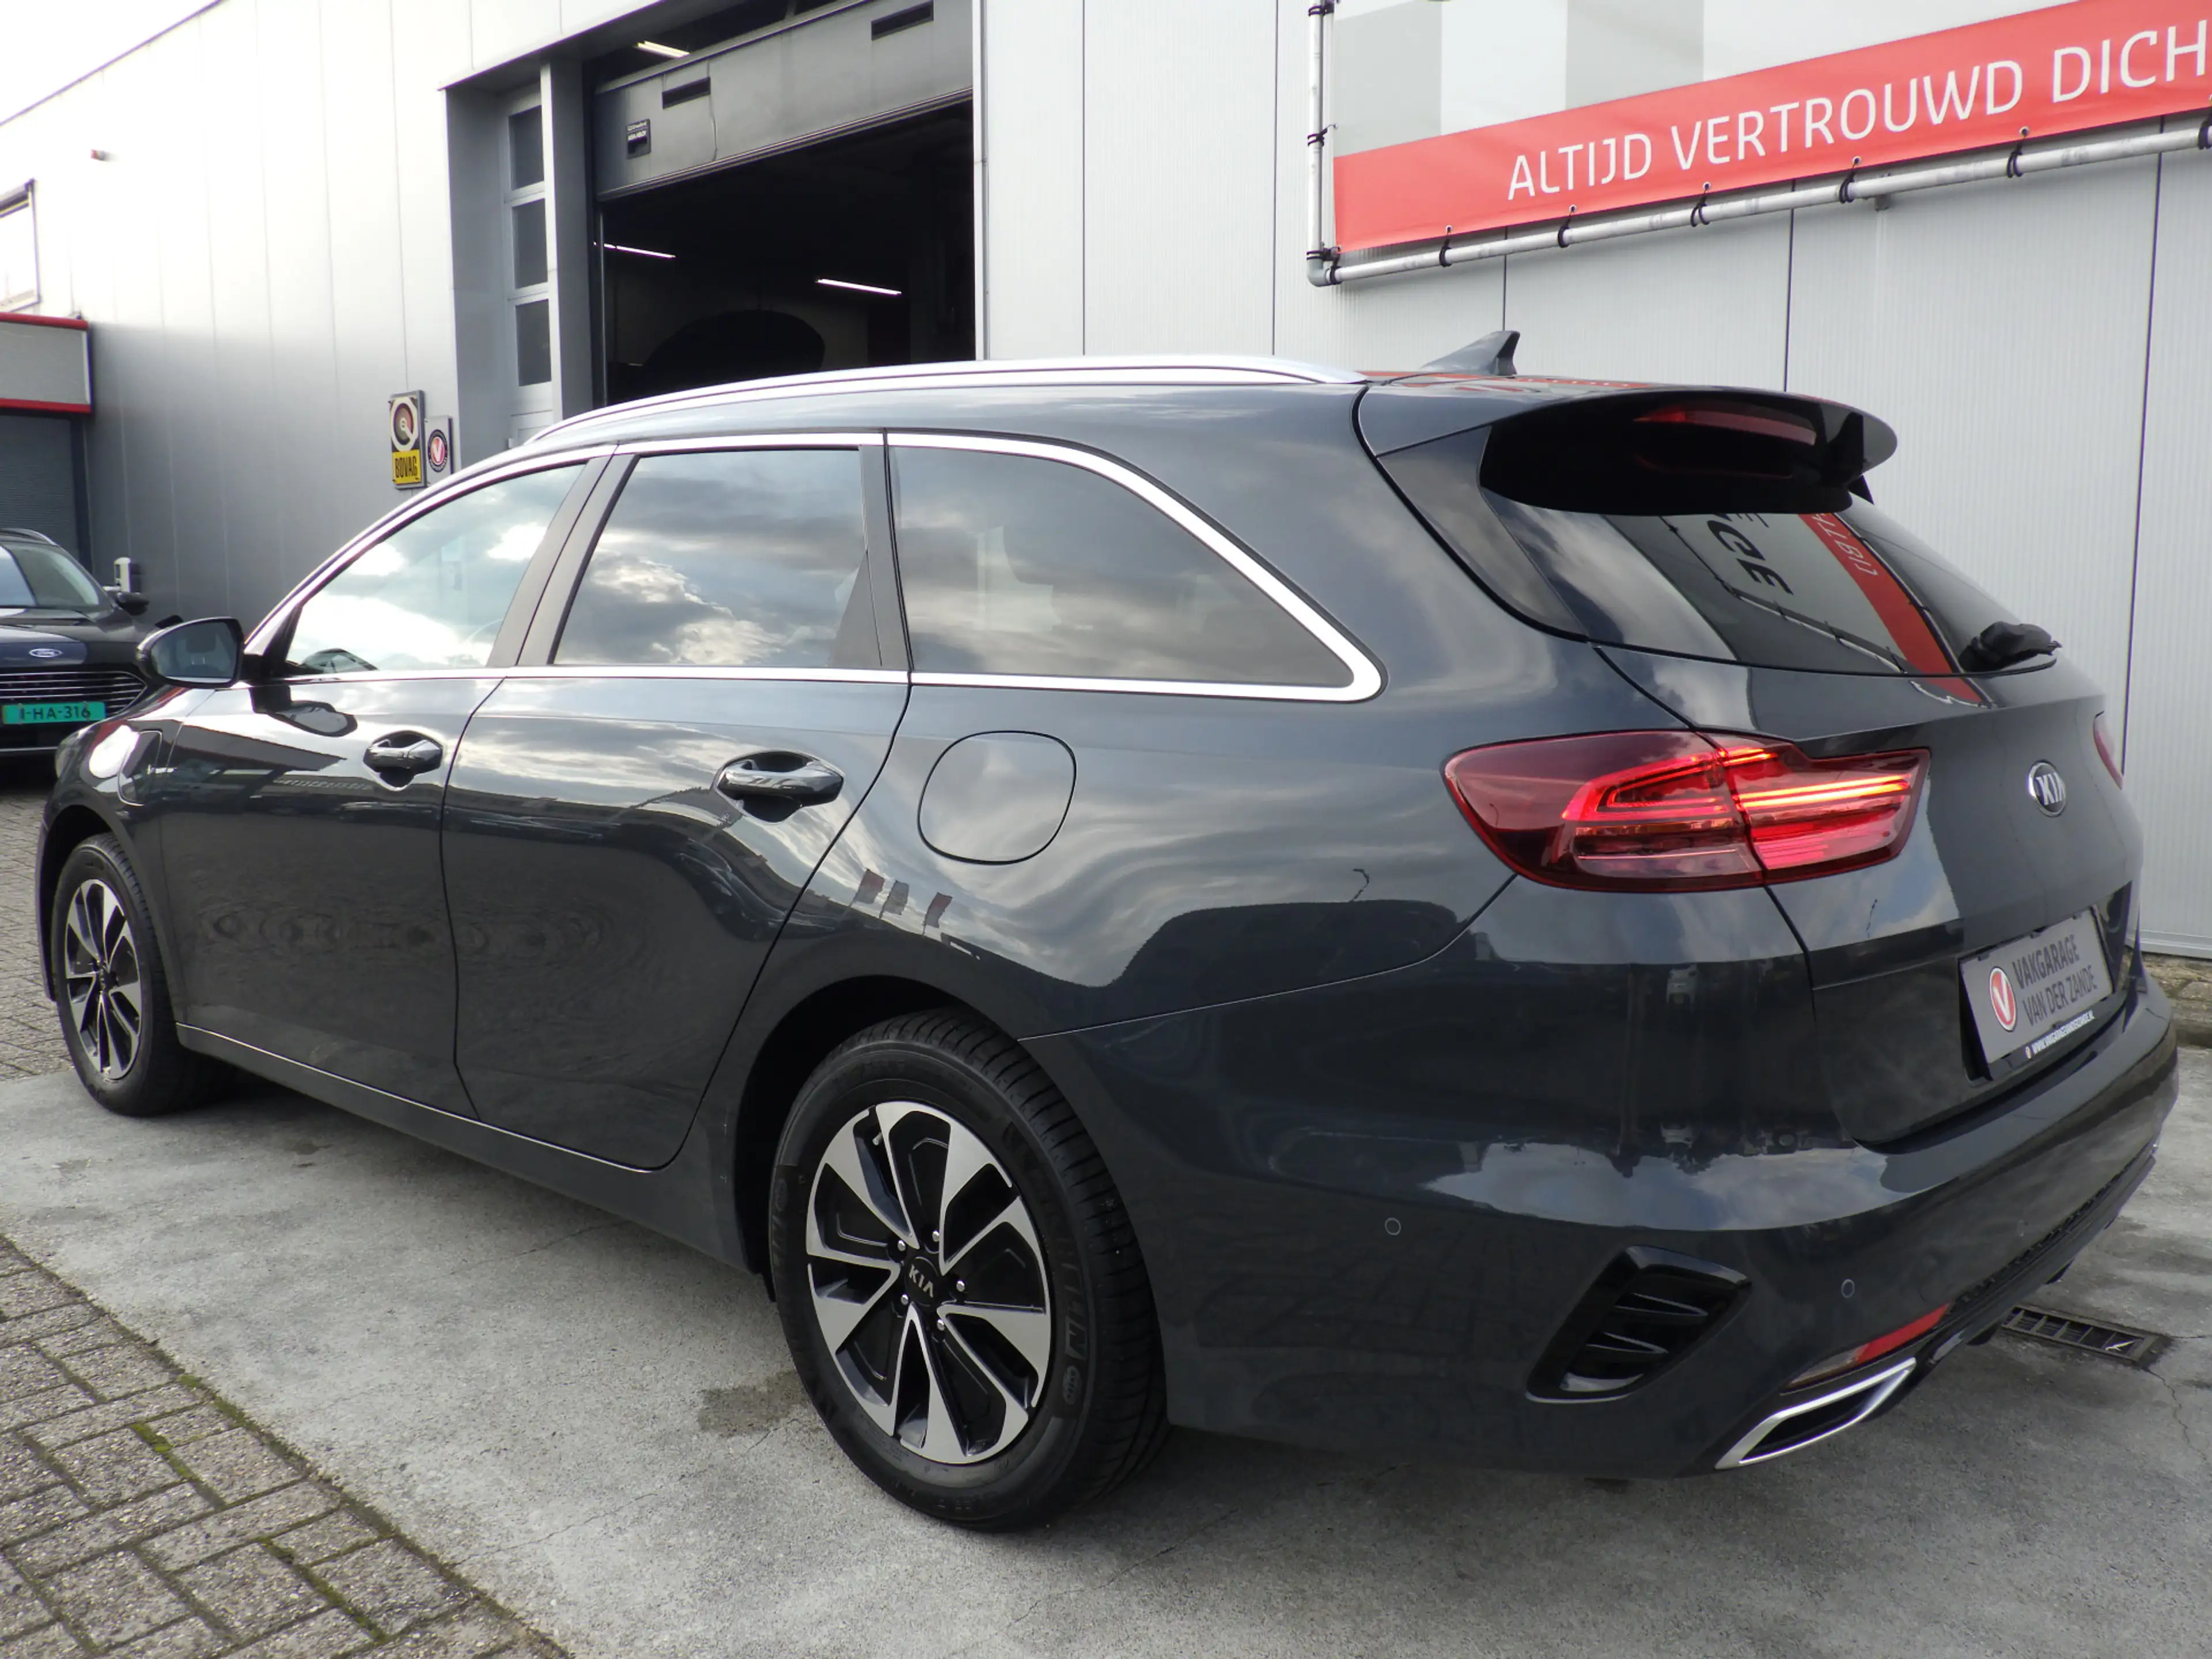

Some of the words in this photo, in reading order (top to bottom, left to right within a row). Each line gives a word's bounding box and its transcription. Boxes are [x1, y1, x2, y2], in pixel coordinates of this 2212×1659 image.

[1508, 133, 1652, 200] ALTIJD
[1672, 60, 2023, 171] VERTROUWD
[2052, 20, 2208, 103] DICH
[395, 456, 418, 478] BOVAG
[2035, 772, 2066, 806] KIA
[2012, 934, 2080, 989] VAKGARAGE
[2022, 991, 2048, 1026] VAN
[2045, 981, 2069, 1014] DER
[2066, 964, 2098, 1003] ZANDE
[908, 1263, 934, 1298] KIA
